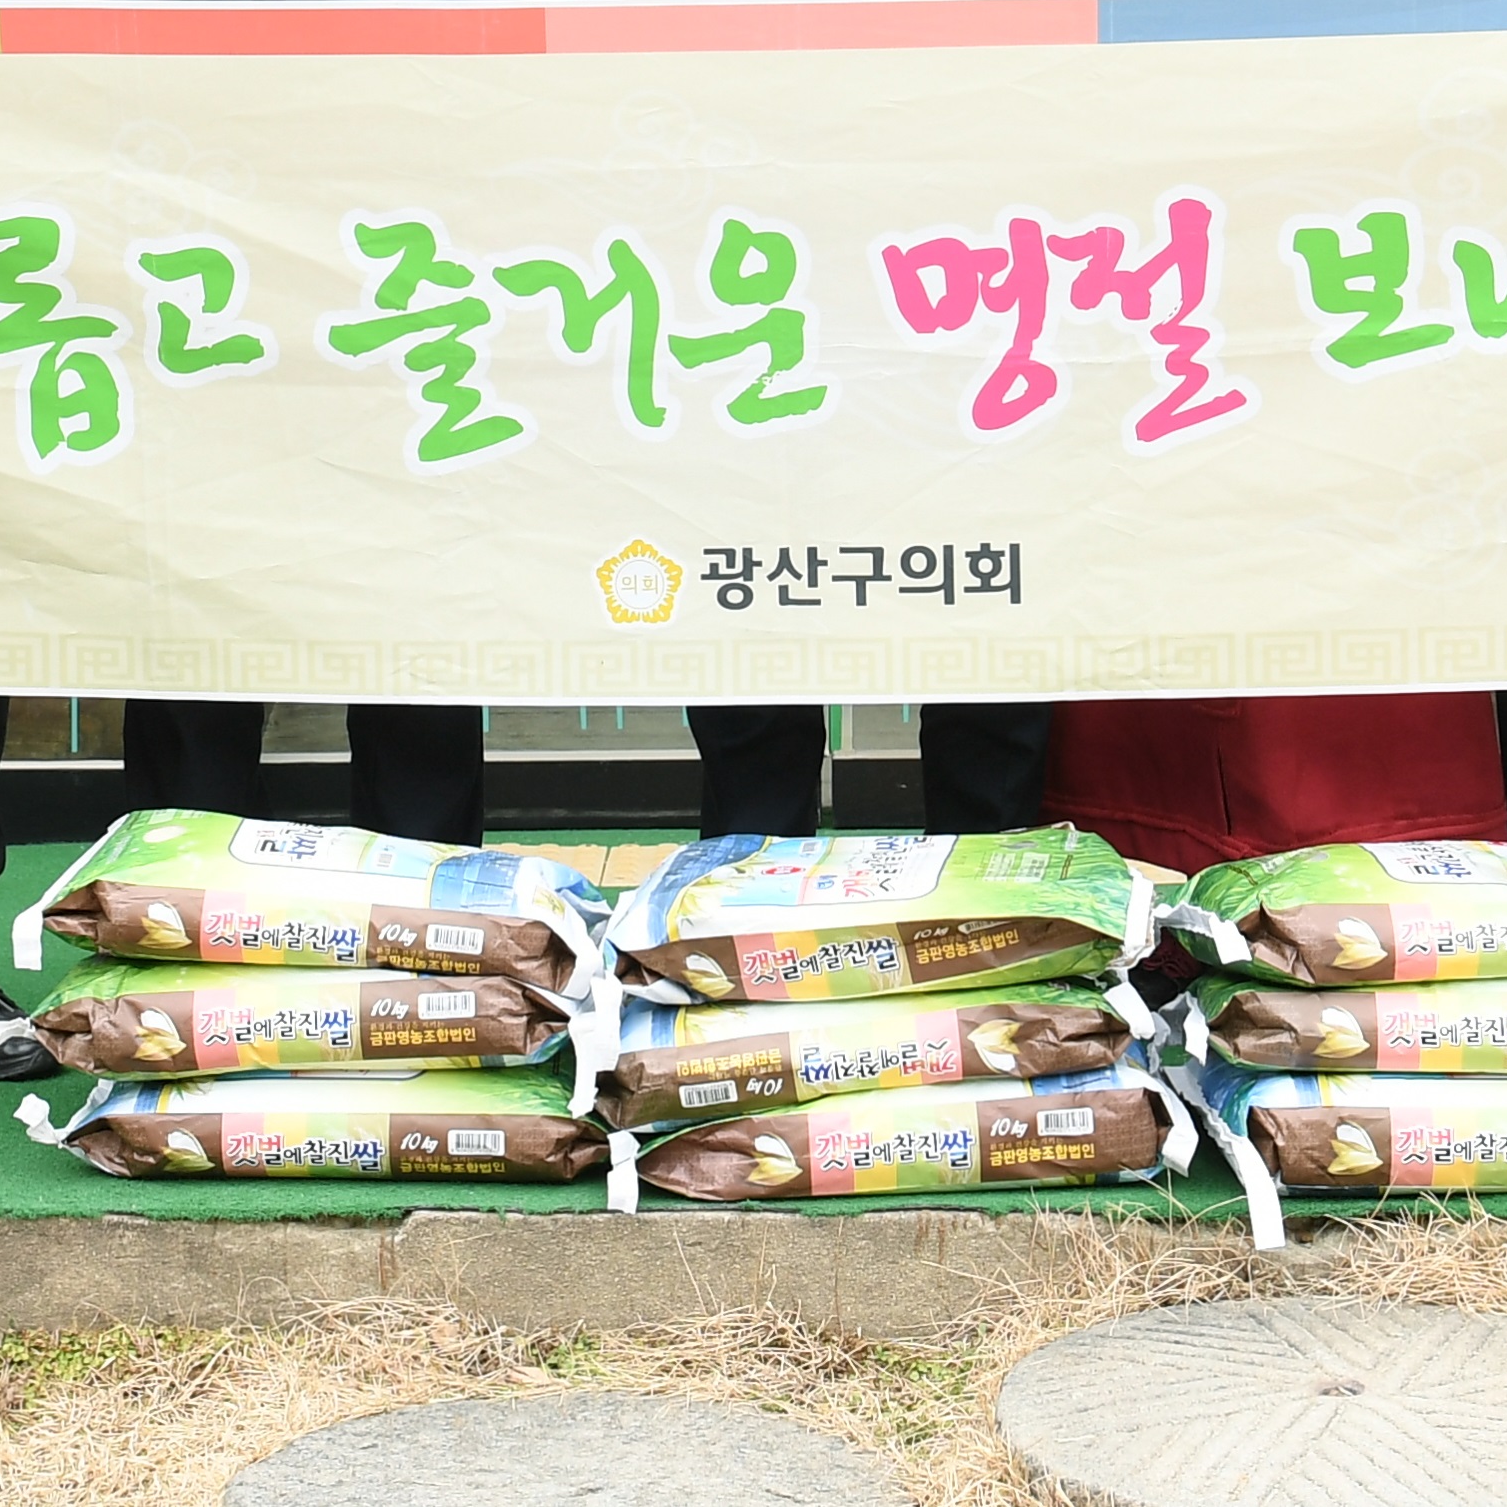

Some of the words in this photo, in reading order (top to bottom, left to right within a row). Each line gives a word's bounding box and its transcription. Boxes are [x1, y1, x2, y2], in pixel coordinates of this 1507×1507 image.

[327, 218, 829, 463] 즐거운
[880, 198, 1248, 443] 명절
[621, 571, 660, 596] 의회
[699, 541, 1023, 612] 광산구의회
[744, 936, 900, 984] 갯벌에찰진쌀
[915, 928, 1021, 965] 금판영농조합법인
[200, 1008, 355, 1047] 갯벌에찰진쌀
[369, 1026, 477, 1047] 금판영농조합법인
[799, 1039, 956, 1084] 갯벌에찰진쌀
[227, 1132, 383, 1173] 갯벌에찰진쌀
[816, 1130, 973, 1169] 갯벌에찰진쌀
[989, 1142, 1096, 1167] 금판영농조합법인
